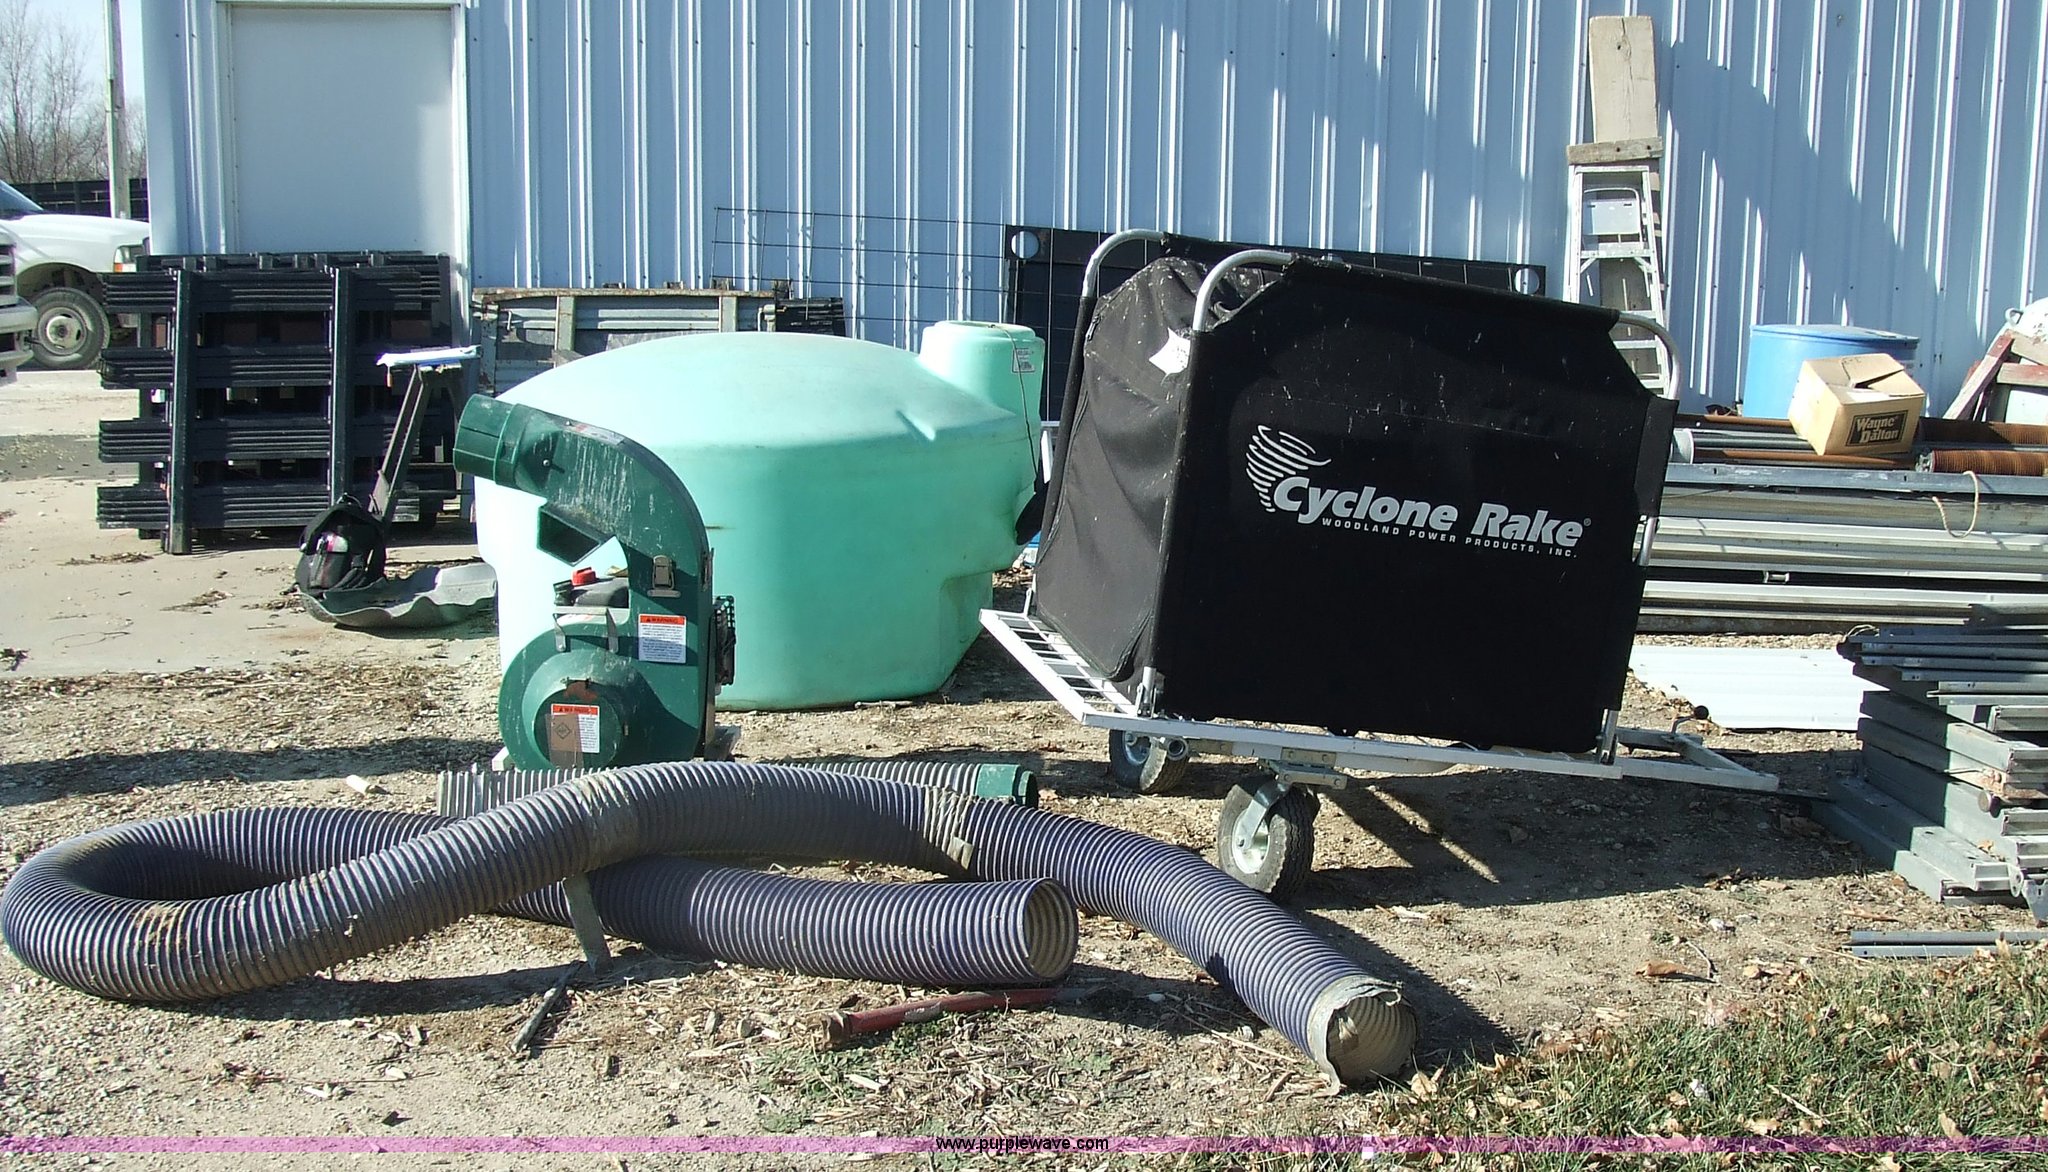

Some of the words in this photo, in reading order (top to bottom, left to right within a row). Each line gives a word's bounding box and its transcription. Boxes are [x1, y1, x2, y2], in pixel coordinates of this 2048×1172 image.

[1856, 417, 1895, 432] Wayne
[1860, 429, 1900, 443] Dalton
[1273, 476, 1459, 531] Cyclone
[1321, 517, 1400, 535] WOODLAND
[1408, 529, 1457, 543] POWER
[1464, 536, 1540, 554] PRODUCTS,
[1548, 546, 1577, 558] INC.
